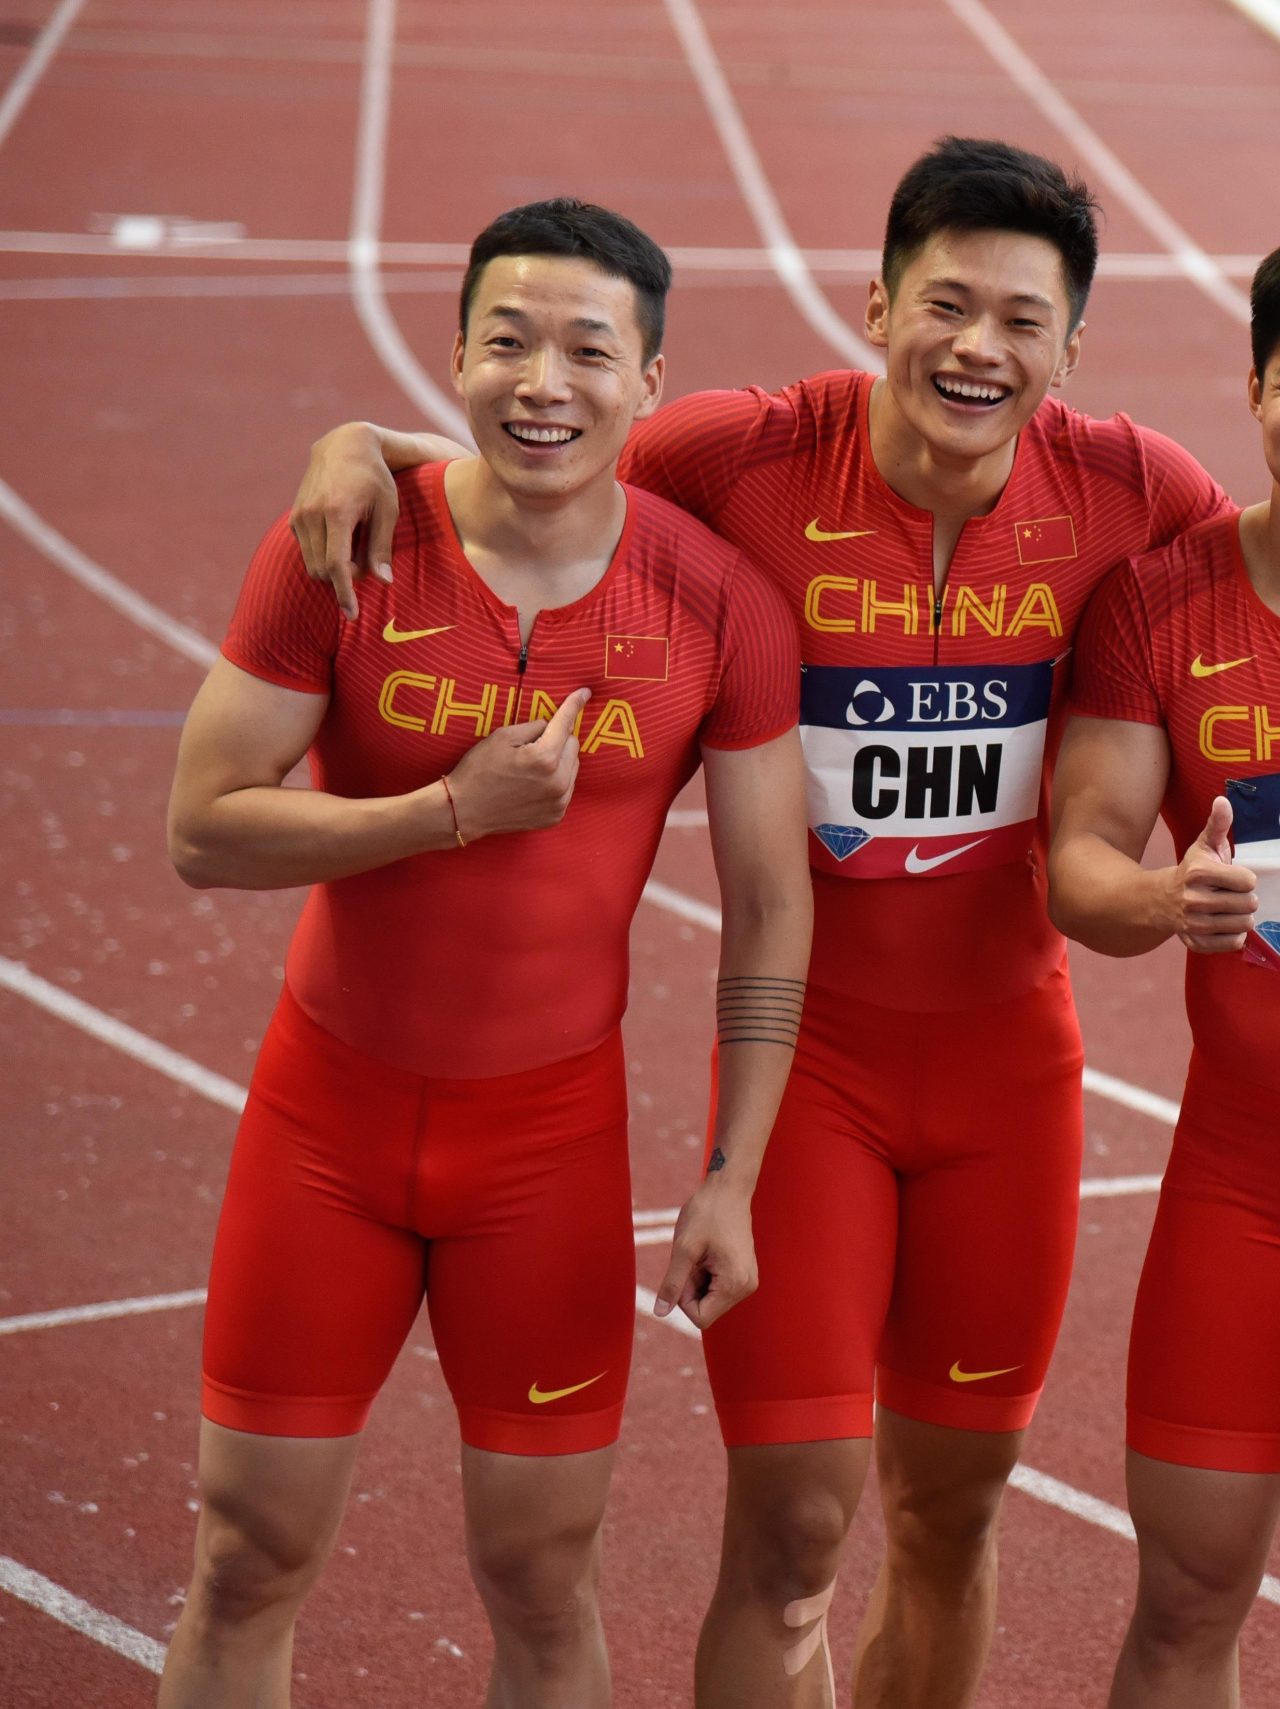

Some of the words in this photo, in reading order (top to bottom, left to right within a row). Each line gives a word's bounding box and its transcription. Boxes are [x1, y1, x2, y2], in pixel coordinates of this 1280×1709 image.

[804, 574, 1063, 637] CHINA
[906, 680, 1008, 723] EBS
[852, 743, 1003, 820] CHN
